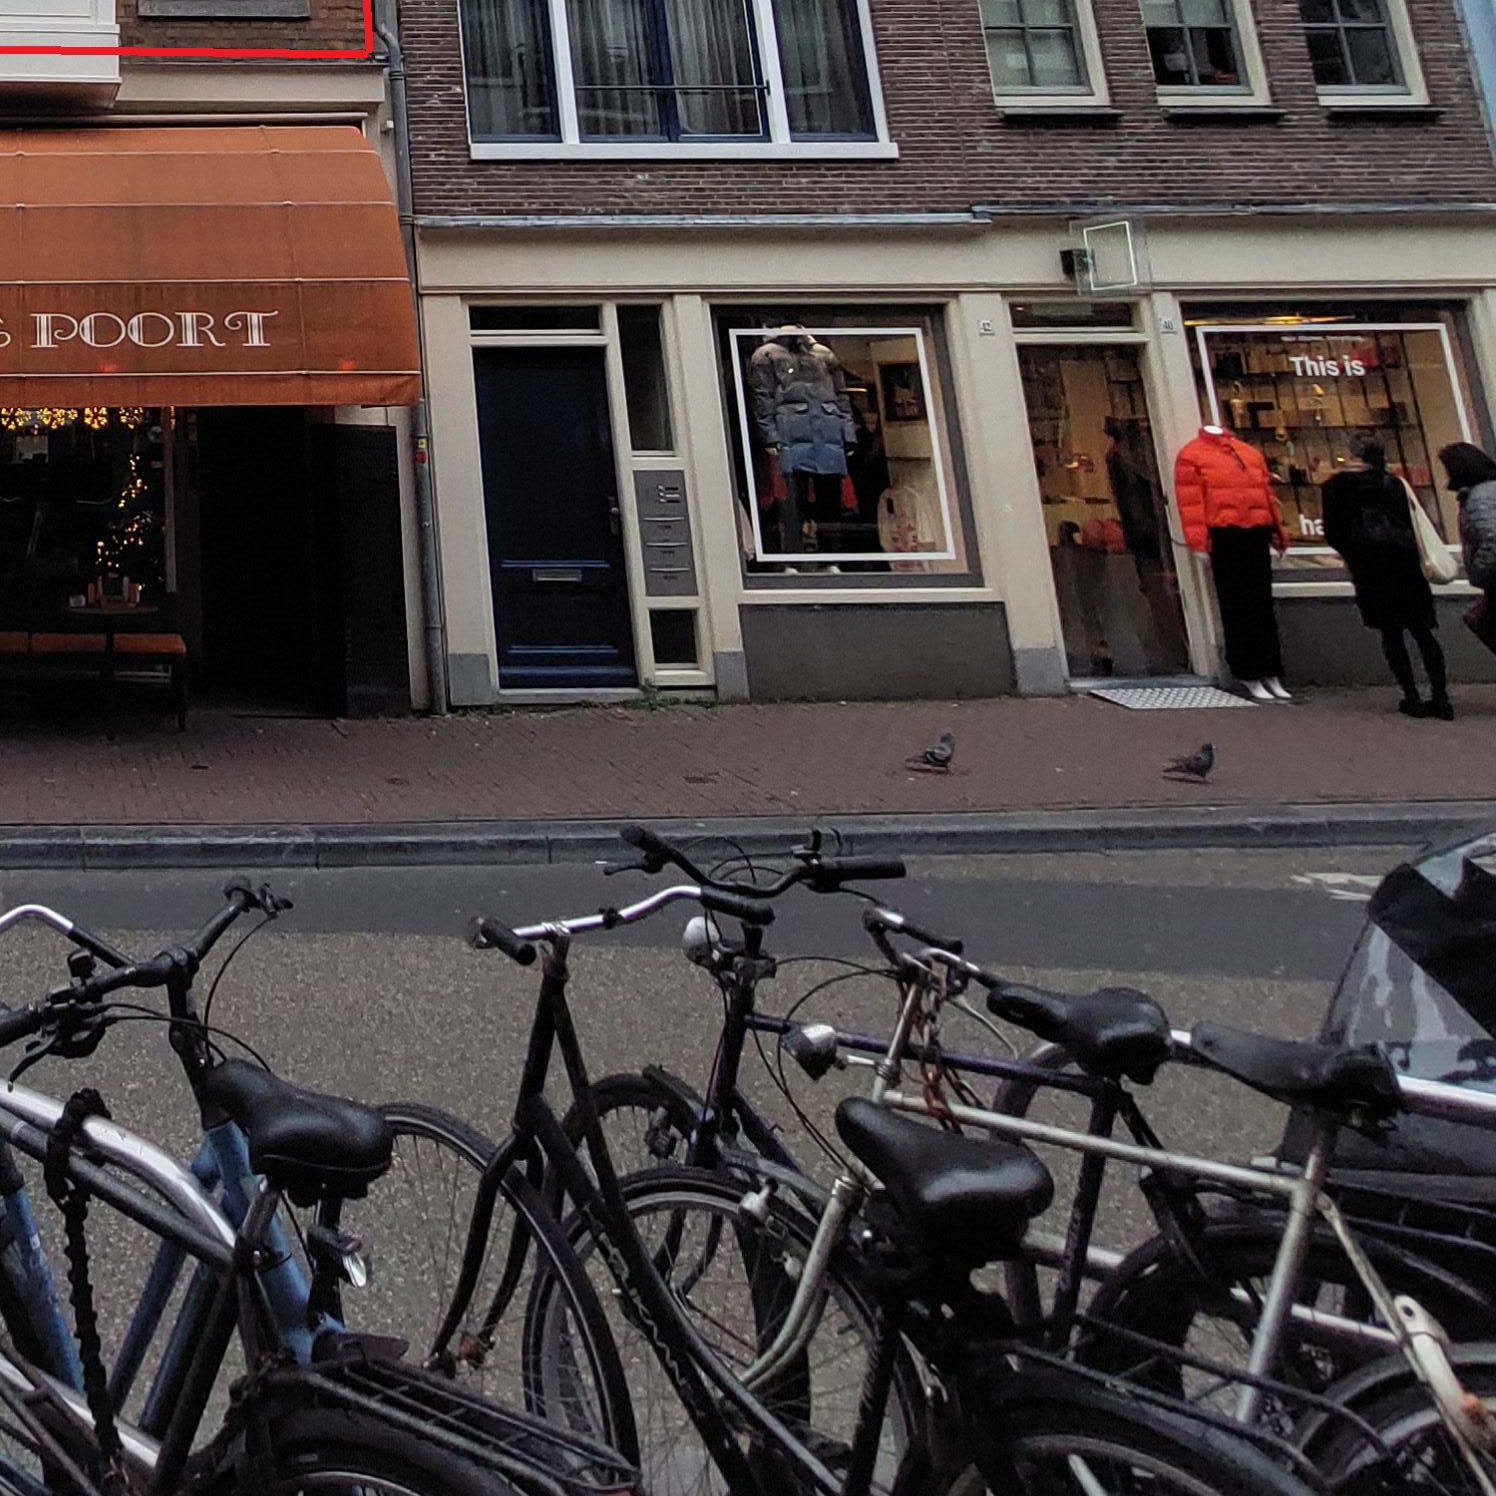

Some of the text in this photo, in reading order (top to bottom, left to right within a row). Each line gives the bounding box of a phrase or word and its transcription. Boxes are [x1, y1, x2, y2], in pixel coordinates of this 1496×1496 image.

[30, 310, 279, 348] POORT
[1288, 354, 1365, 376] This is
